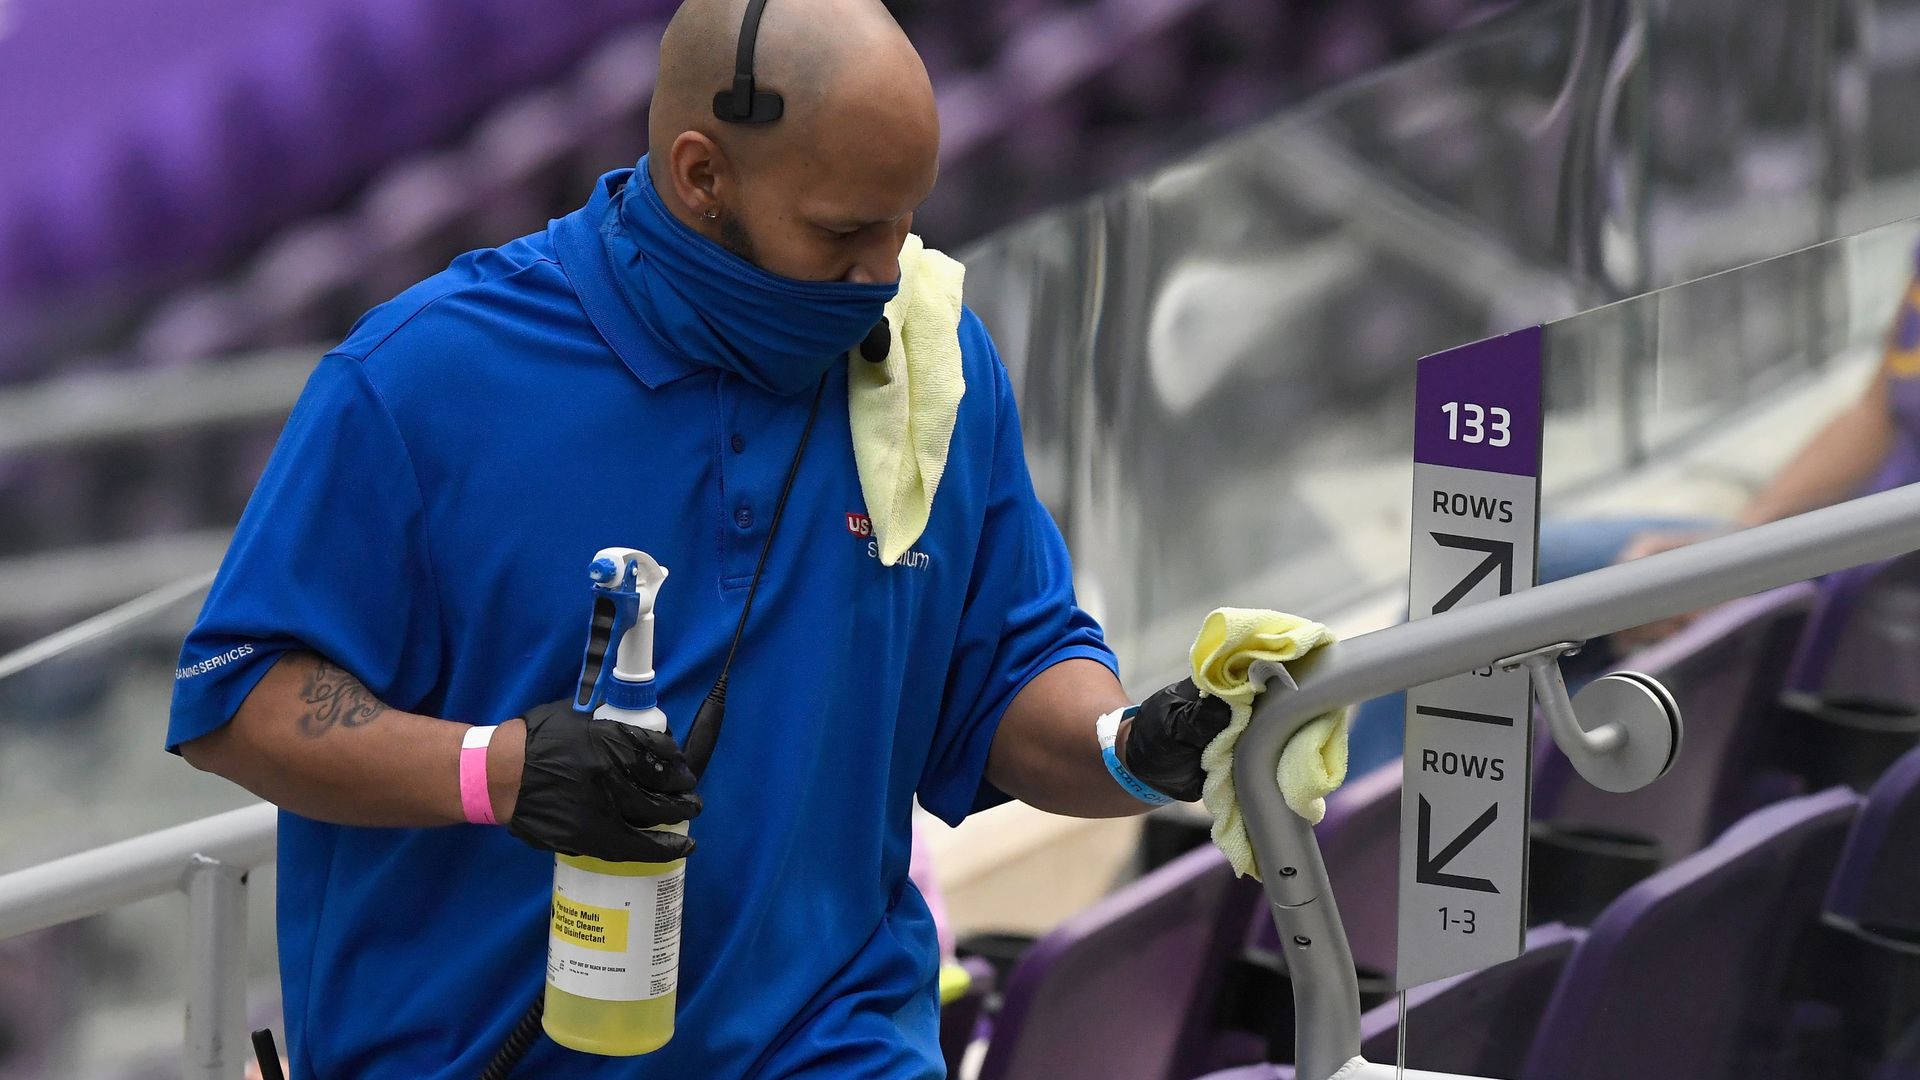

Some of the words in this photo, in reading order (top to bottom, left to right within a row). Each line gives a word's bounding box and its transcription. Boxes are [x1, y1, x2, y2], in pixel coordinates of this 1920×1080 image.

[1441, 402, 1511, 447] 133
[1432, 490, 1513, 523] ROWS
[199, 643, 254, 673] SERVICES
[1422, 748, 1504, 781] ROWS
[556, 900, 578, 917] Peroxide
[580, 910, 600, 922] Multi
[556, 910, 575, 926] Surface
[576, 920, 604, 933] Cleaner
[1438, 906, 1475, 934] 1-3
[563, 926, 605, 943] Disinfectant
